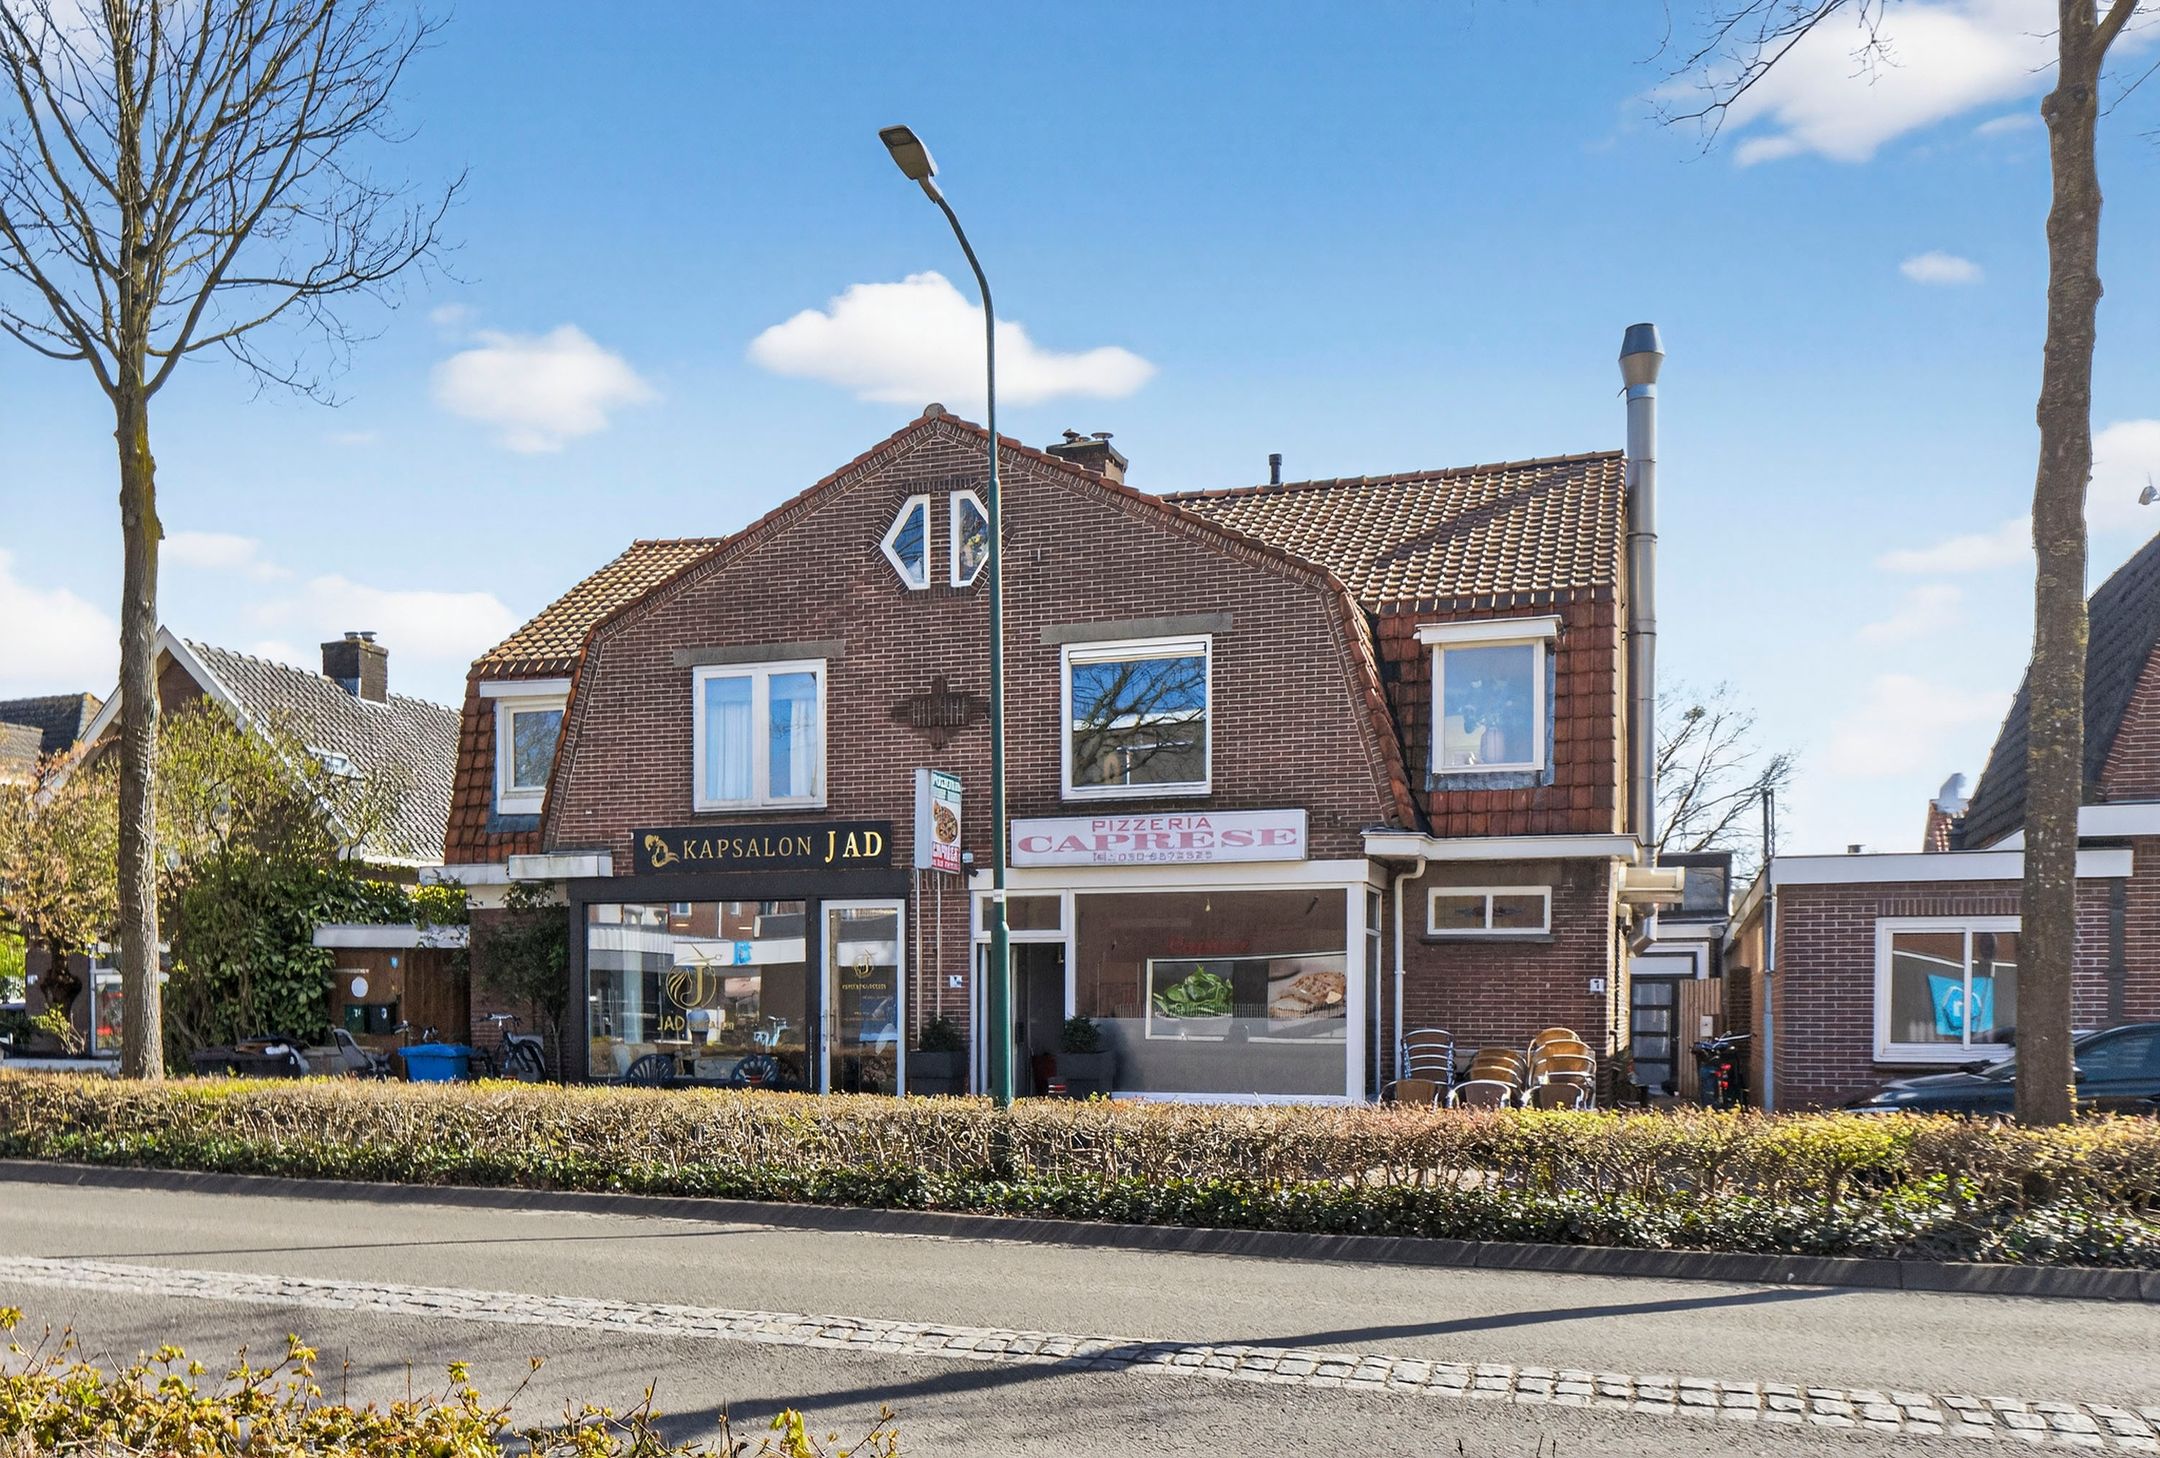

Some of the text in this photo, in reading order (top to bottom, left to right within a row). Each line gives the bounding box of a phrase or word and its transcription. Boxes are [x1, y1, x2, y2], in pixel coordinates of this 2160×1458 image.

[1092, 817, 1212, 832] PIZZERIA
[683, 830, 883, 864] KAPSALON JAD
[1017, 827, 1297, 853] CAPRESE
